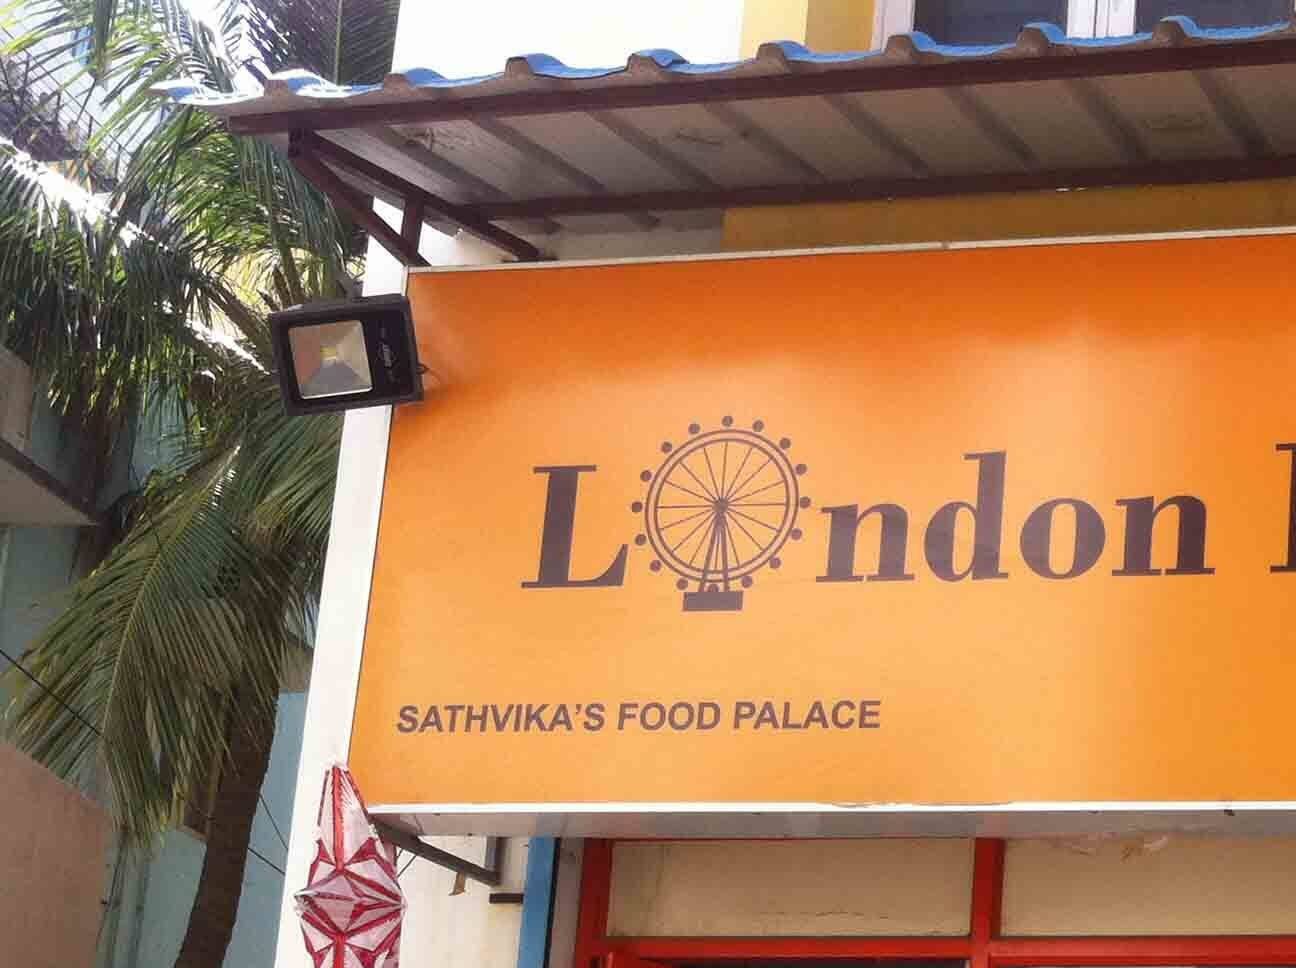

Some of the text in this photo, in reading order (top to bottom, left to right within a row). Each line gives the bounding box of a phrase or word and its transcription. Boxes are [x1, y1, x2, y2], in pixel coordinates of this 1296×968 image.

[520, 414, 1217, 612] London
[396, 699, 881, 735] SATHVIKA'S FOOD PALACE
